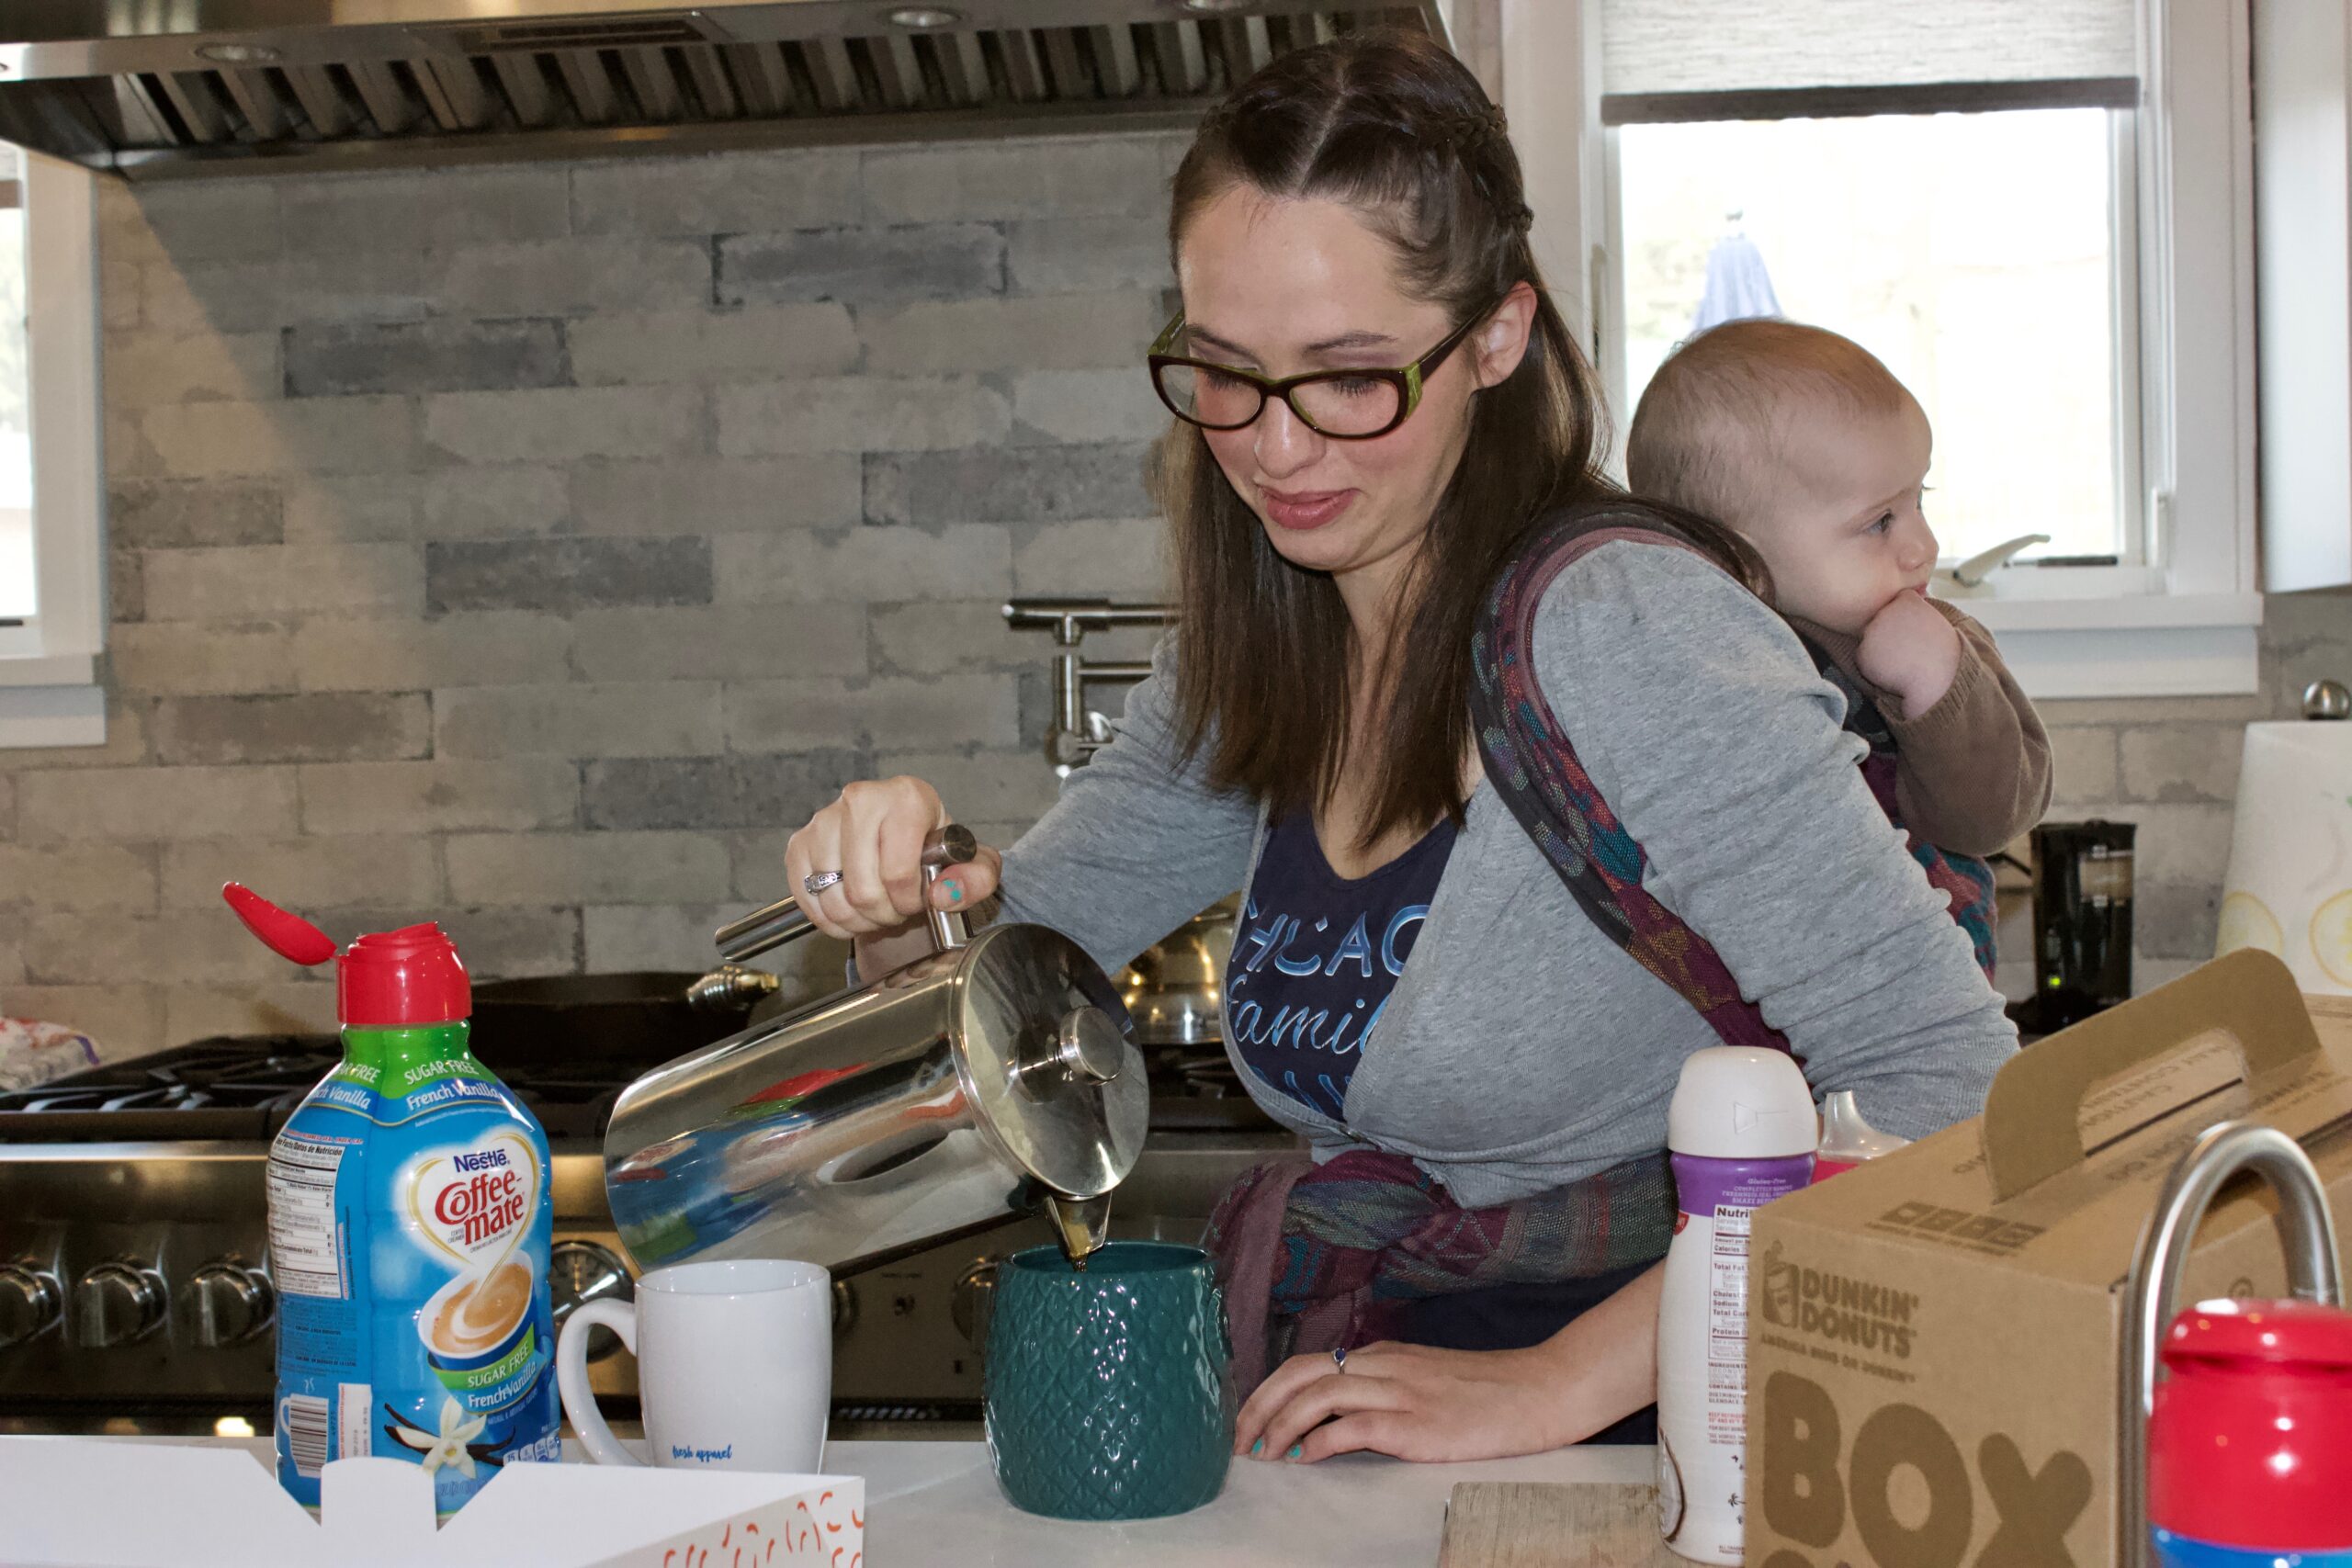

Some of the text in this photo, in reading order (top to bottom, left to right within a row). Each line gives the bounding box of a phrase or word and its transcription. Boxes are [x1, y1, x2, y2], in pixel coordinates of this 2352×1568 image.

[354, 1064, 381, 1084] FREE
[404, 1060, 480, 1085] SUGAR FREE
[329, 1086, 371, 1111] Vanilla
[406, 1081, 503, 1111] French Vanilla
[464, 1193, 524, 1246] mate
[1716, 1206, 1749, 1219] Nutri
[1713, 1262, 1731, 1271] Total
[1713, 1299, 1739, 1307] Sodium
[1802, 1268, 1919, 1325] DUNKIN'
[1713, 1308, 1731, 1316] Total
[1712, 1327, 1740, 1337] Protein
[1801, 1301, 1911, 1359] DONUTS
[468, 1340, 530, 1388] SUGAR FREE
[467, 1360, 537, 1408] French Vanilla
[673, 1444, 732, 1462] fresh apparel
[1763, 1370, 2094, 1568] BOX
